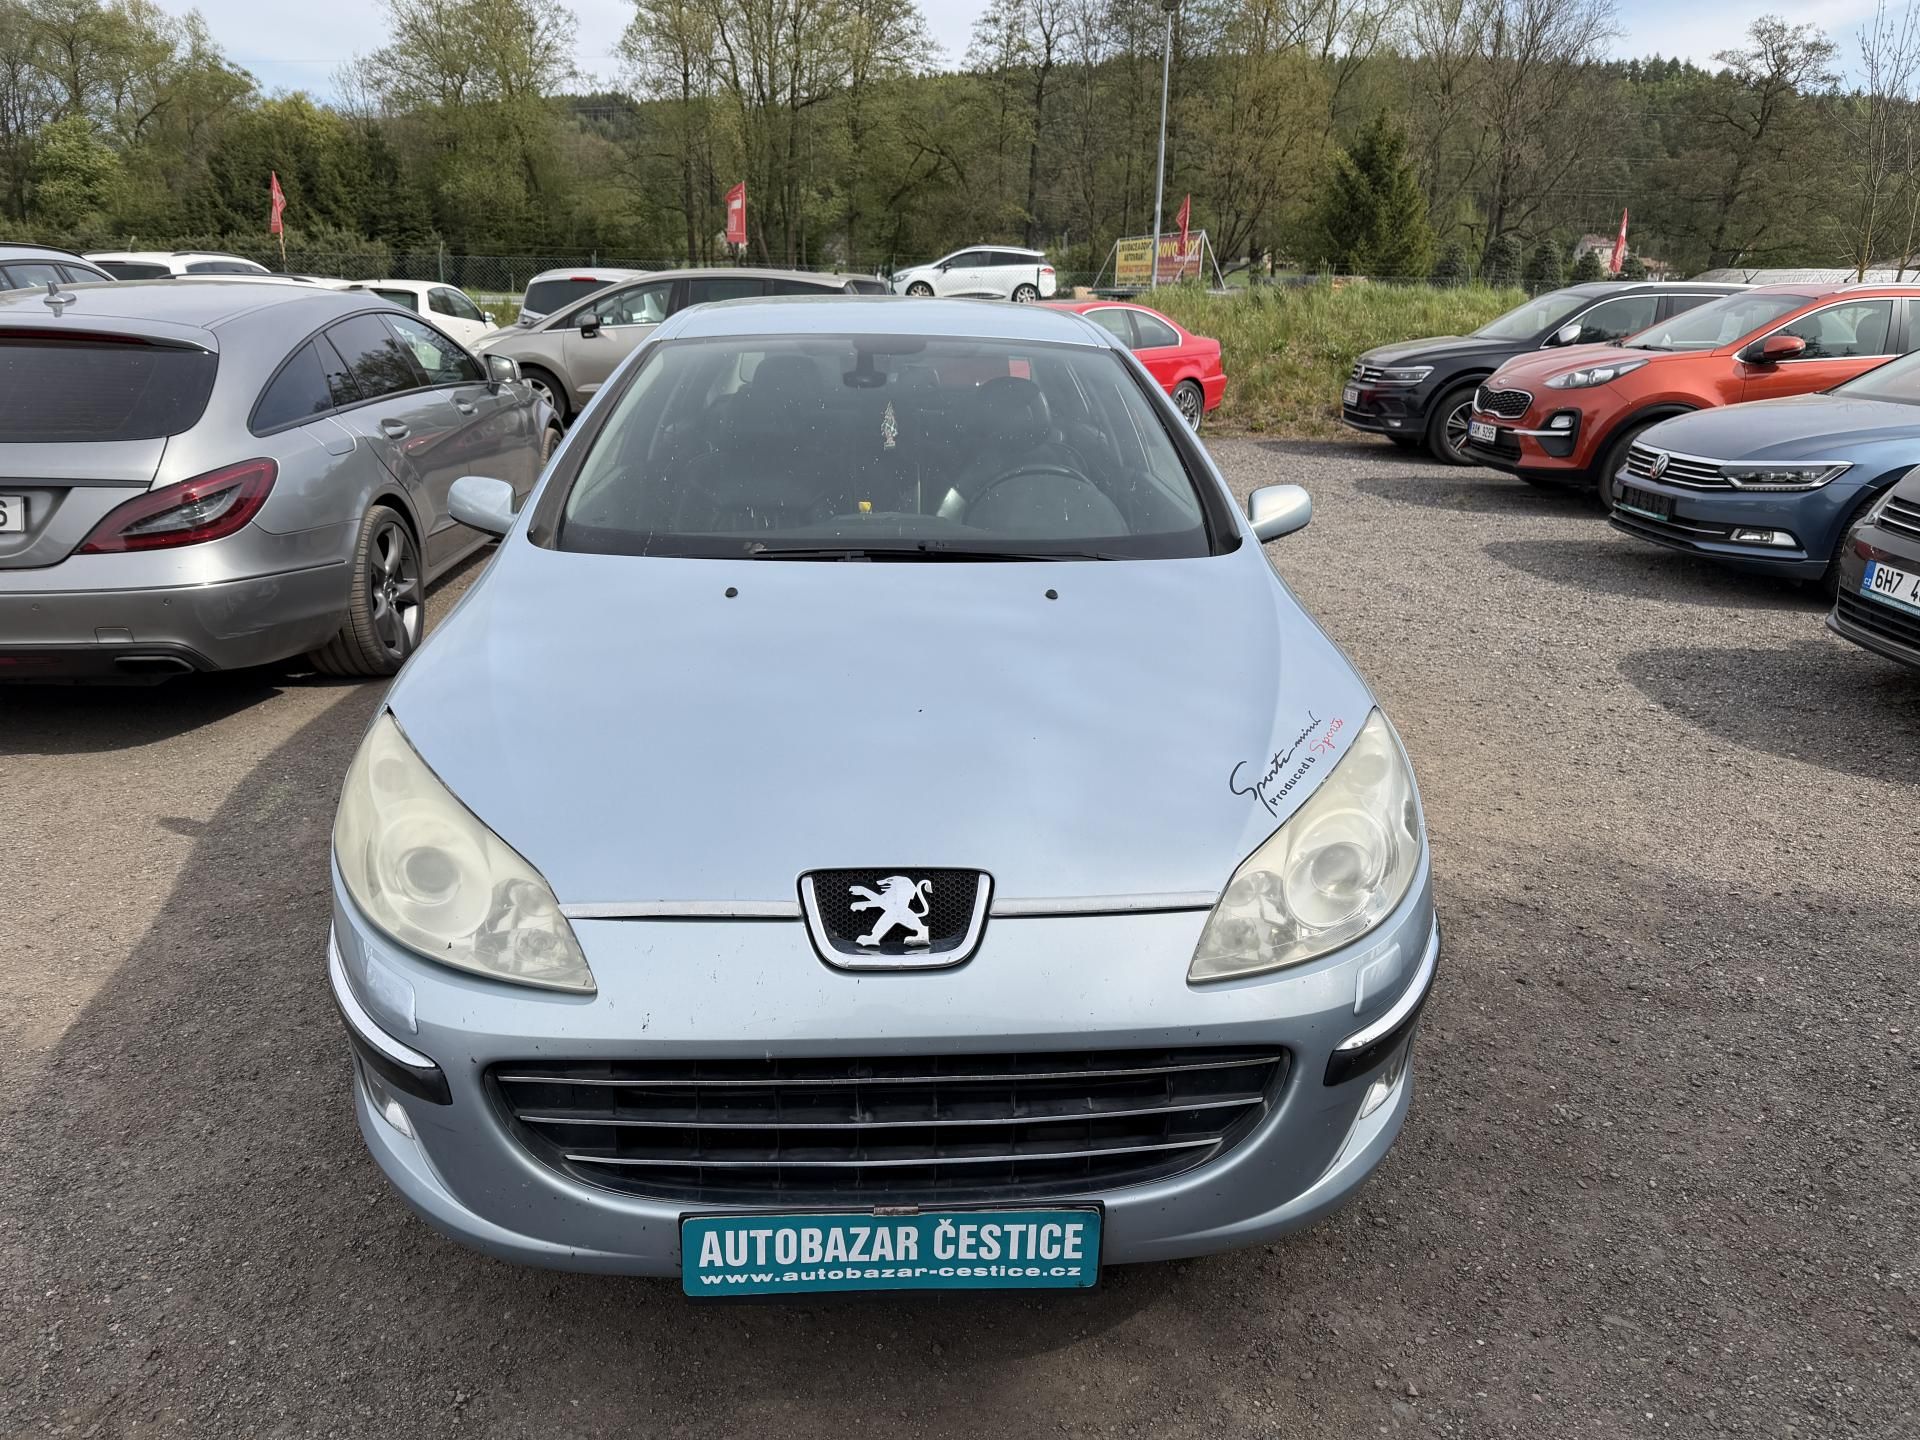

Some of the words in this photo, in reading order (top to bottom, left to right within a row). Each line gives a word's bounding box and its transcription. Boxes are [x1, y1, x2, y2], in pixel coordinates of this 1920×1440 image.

[1875, 567, 1904, 593] 6H7
[1269, 762, 1310, 806] Produced
[1309, 718, 1344, 754] Sports
[699, 1226, 919, 1268] AUTOBAZAR
[933, 1219, 1084, 1260] ČESTICE
[700, 1265, 1081, 1284] www.autobazar-cestice.cz
